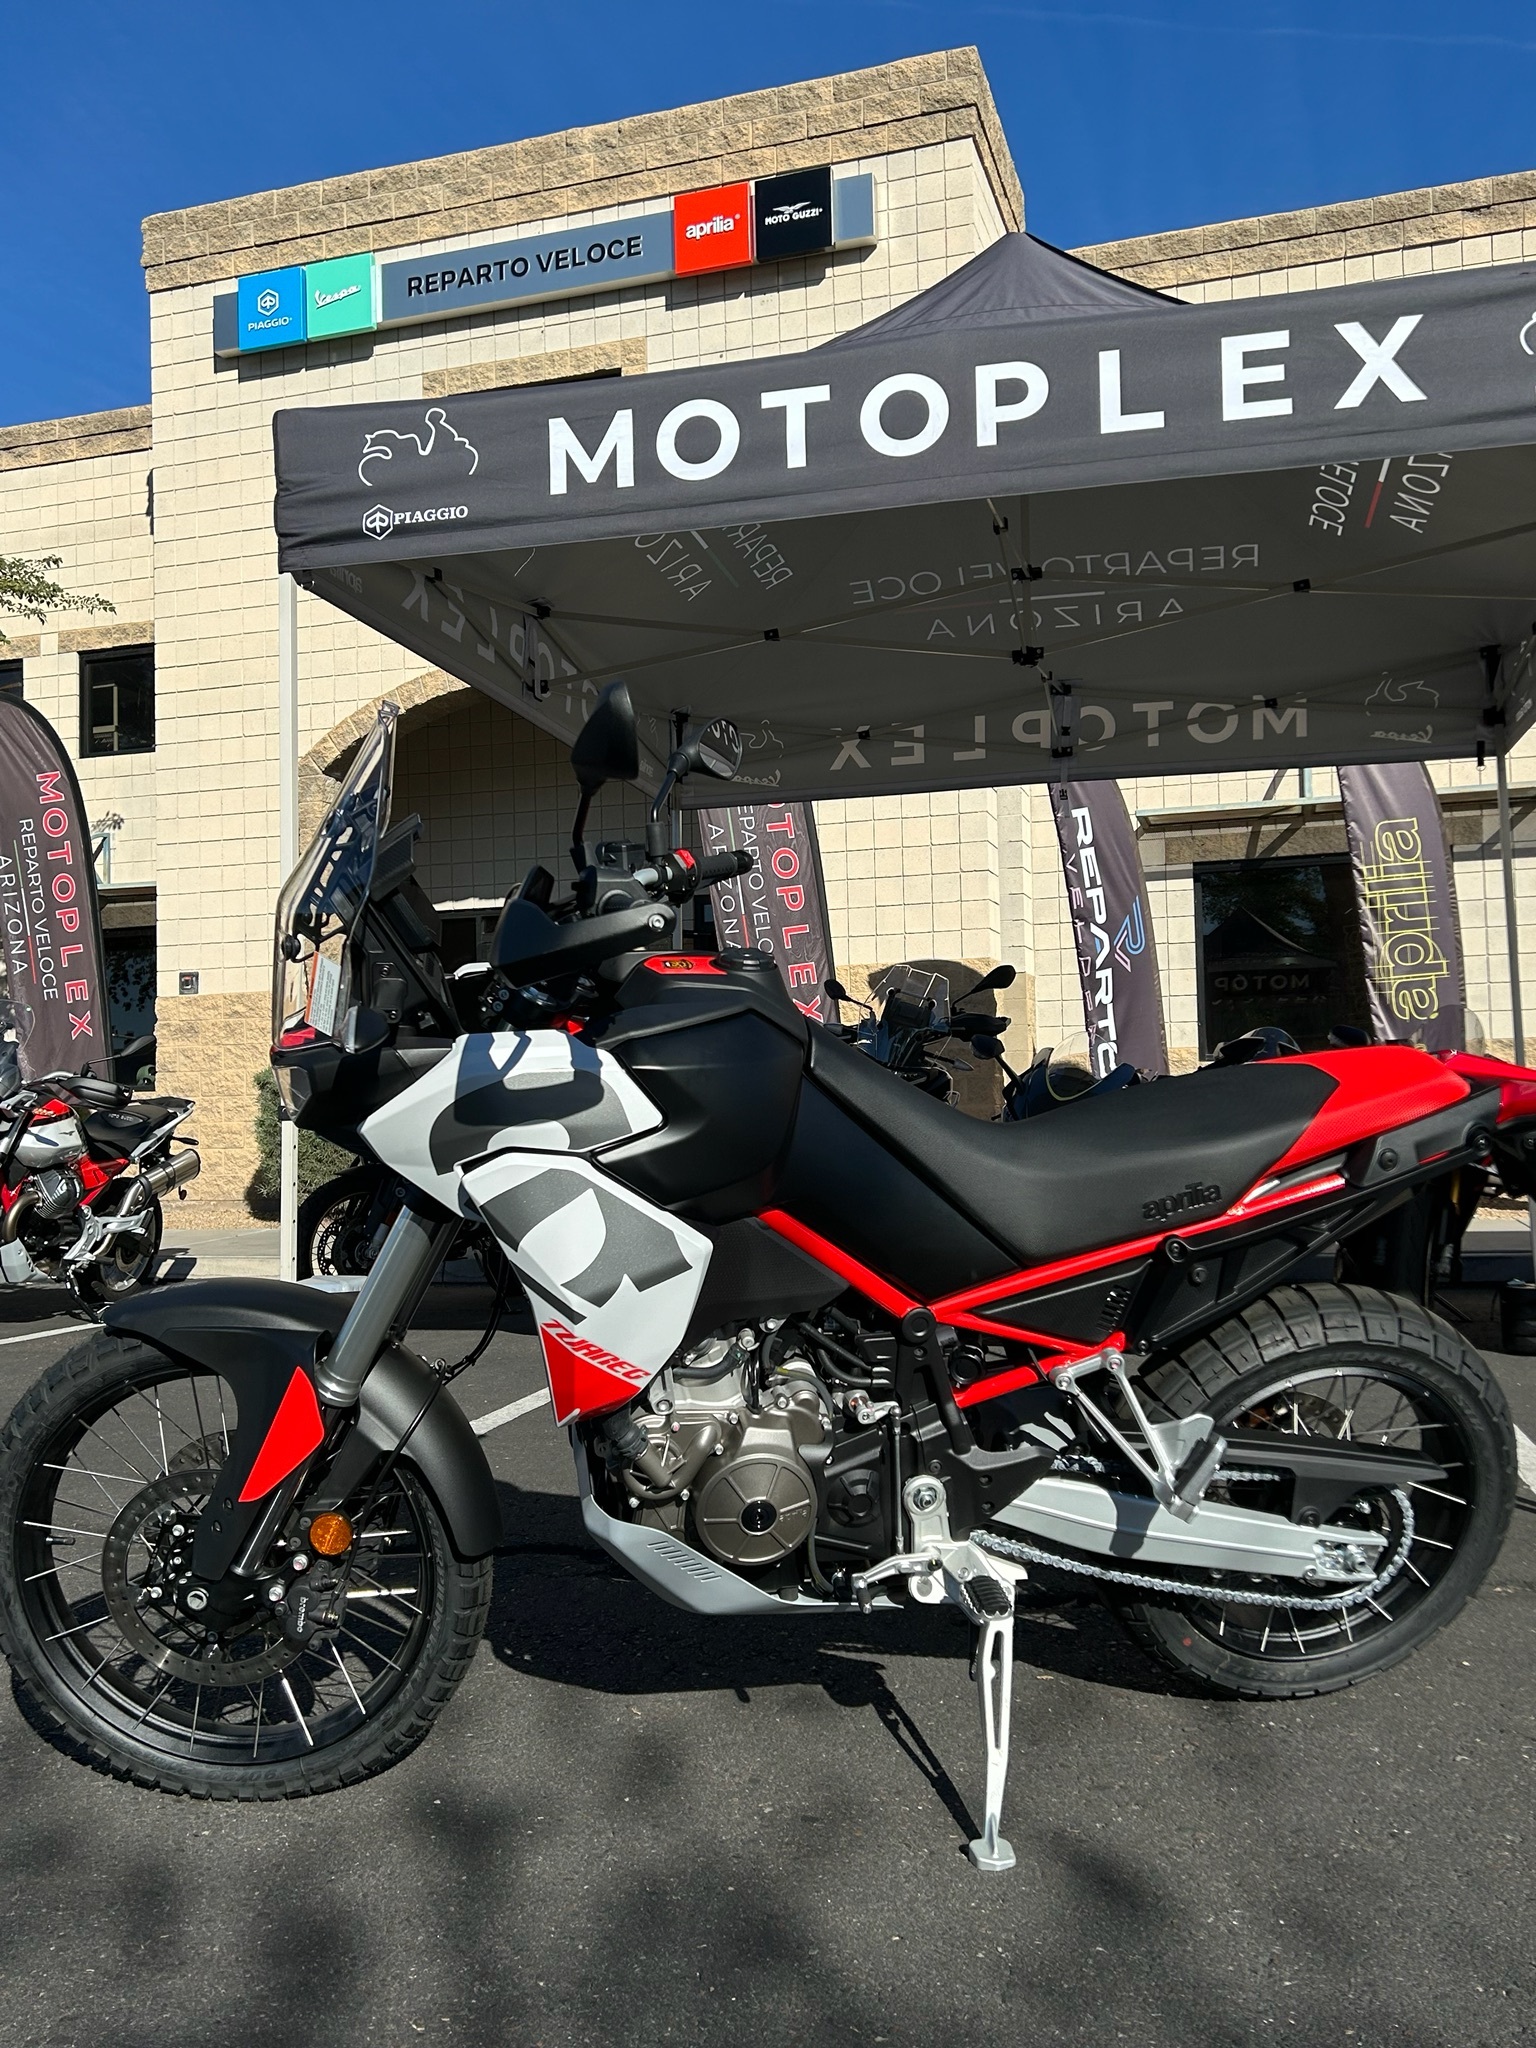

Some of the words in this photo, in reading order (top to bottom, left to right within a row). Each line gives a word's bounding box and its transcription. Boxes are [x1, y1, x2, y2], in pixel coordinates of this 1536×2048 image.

[685, 215, 735, 240] aprilia
[764, 212, 791, 226] MOTO
[792, 207, 820, 220] GUZZI
[407, 256, 530, 298] REPARTO
[535, 234, 643, 275] VELOCE
[314, 284, 362, 309] Vespa
[247, 316, 290, 331] PIAGGIO
[547, 313, 1428, 496] MOTOPLEX
[393, 505, 469, 525] PIAGGIO
[19, 818, 45, 914] REPARTO
[34, 917, 59, 1001] VELOCE
[36, 770, 94, 1041] MOTOPLEX
[296, 1596, 309, 1633] brembo
